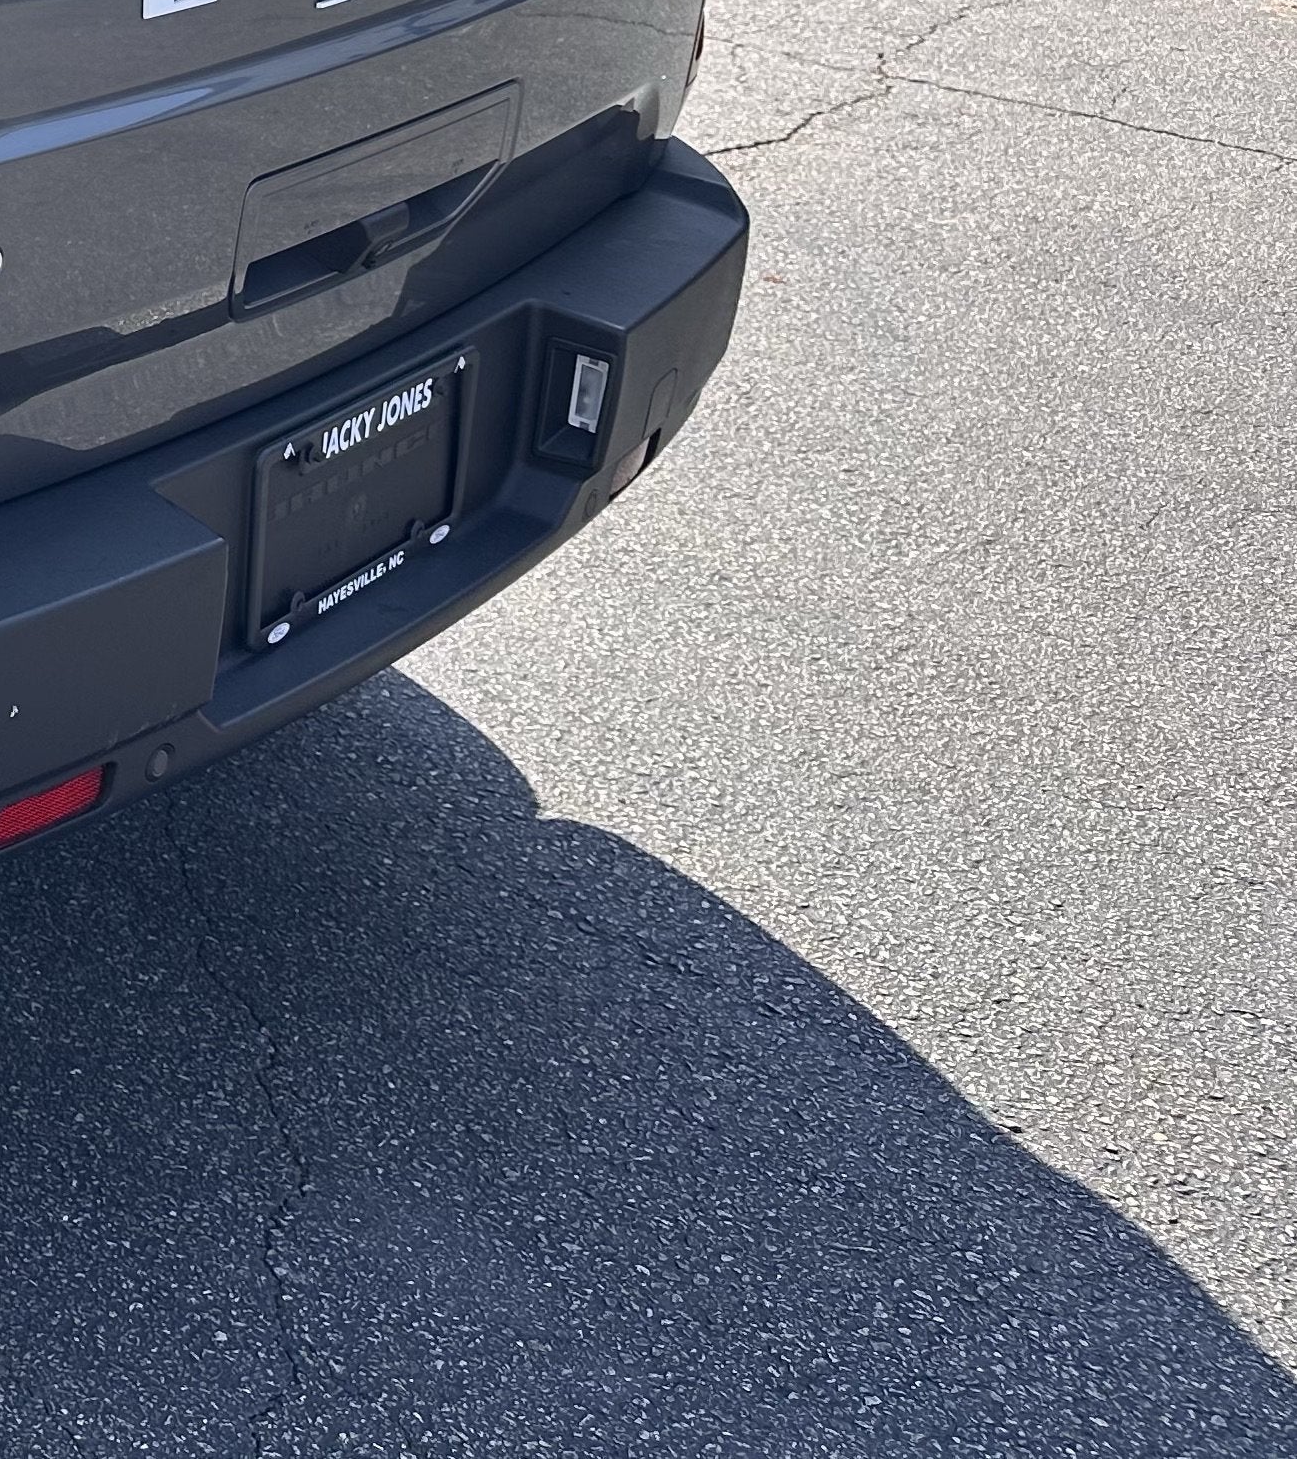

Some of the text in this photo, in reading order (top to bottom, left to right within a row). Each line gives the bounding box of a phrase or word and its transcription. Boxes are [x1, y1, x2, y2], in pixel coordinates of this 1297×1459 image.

[376, 378, 433, 432] JONES
[317, 550, 405, 615] HAYESVILLE, NC
